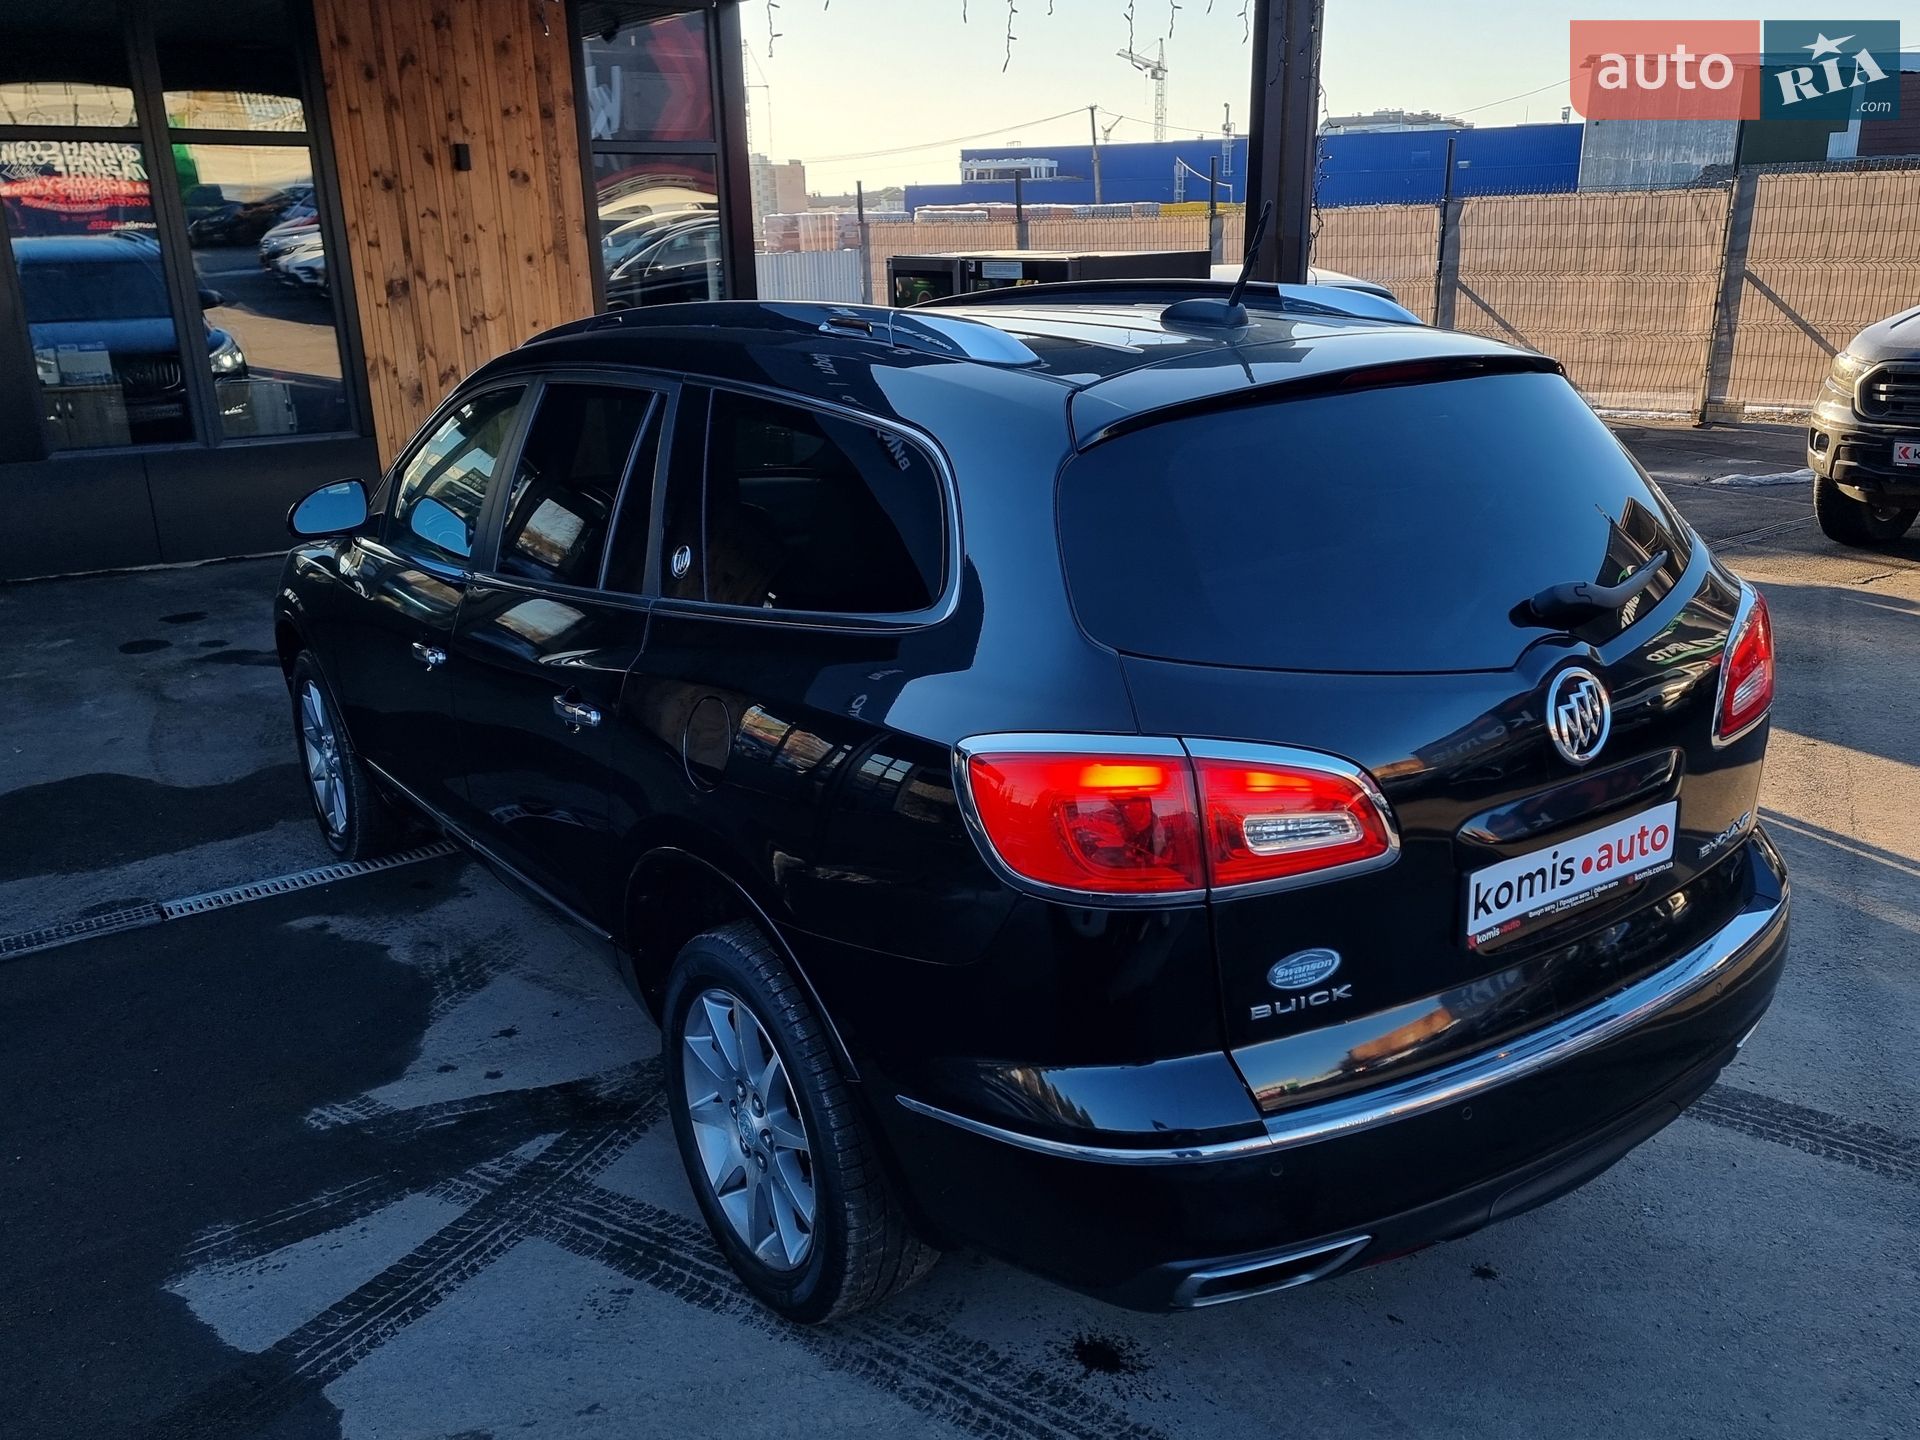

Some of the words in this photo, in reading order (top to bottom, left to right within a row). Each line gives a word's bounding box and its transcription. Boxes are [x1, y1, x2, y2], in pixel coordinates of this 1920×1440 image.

[1634, 862, 1674, 882] komis.com.ua
[1275, 958, 1333, 978] Swanson
[1250, 984, 1352, 1021] BUICK
